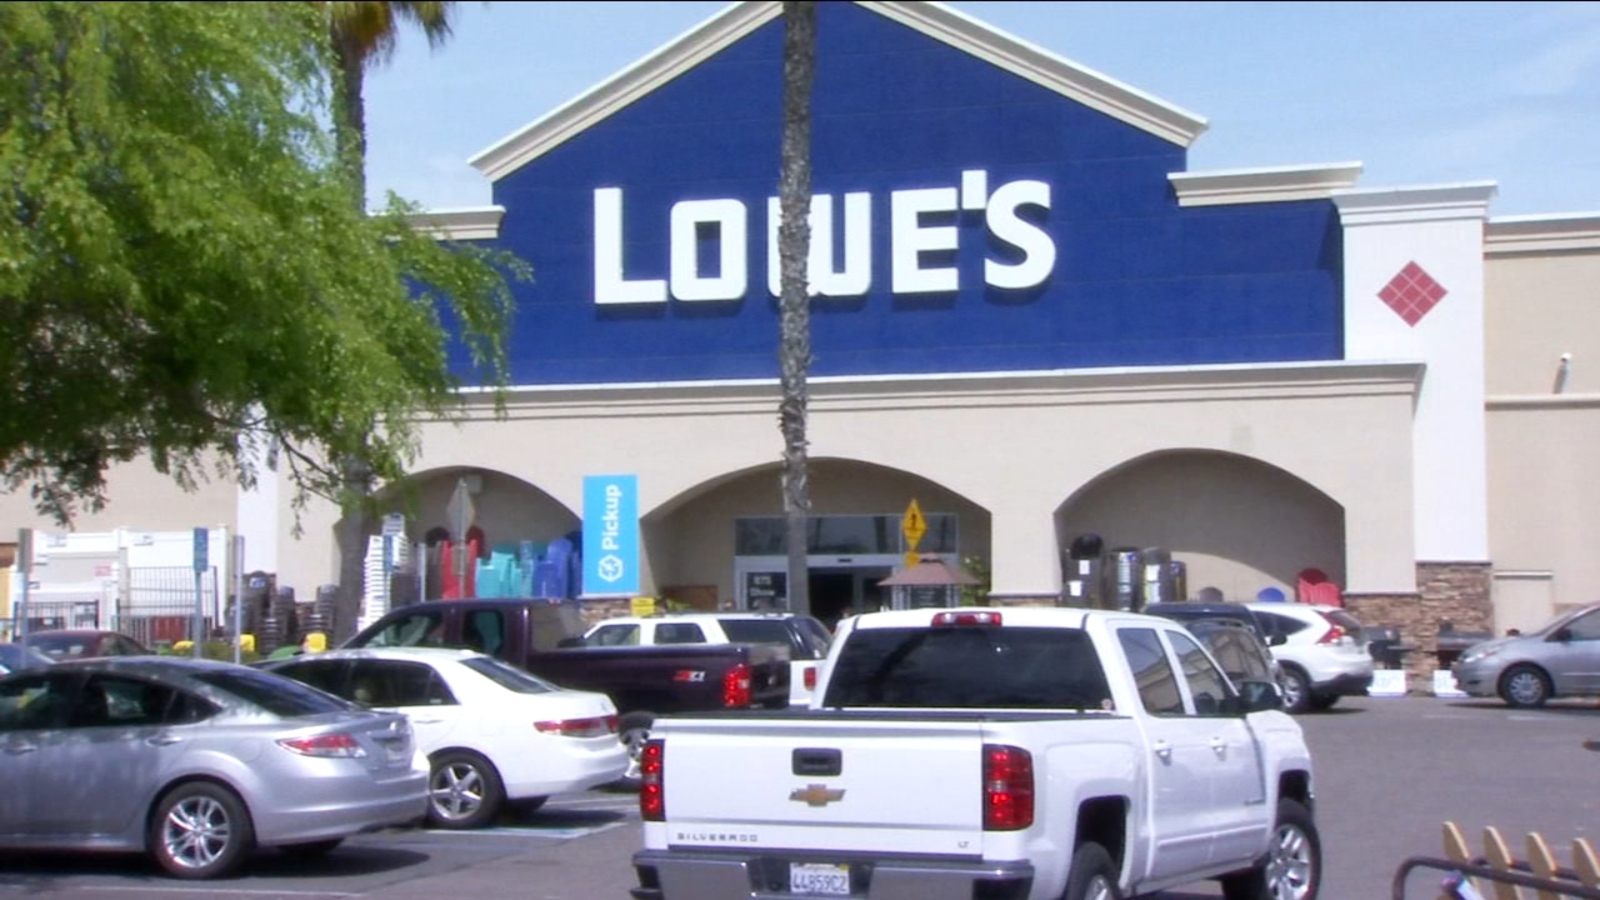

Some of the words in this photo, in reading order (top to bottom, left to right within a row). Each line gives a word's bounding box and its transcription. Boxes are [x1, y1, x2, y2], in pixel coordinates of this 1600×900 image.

[594, 169, 1057, 305] LOWE'S
[601, 483, 623, 550] Pickup
[677, 832, 758, 842] SILVERADO
